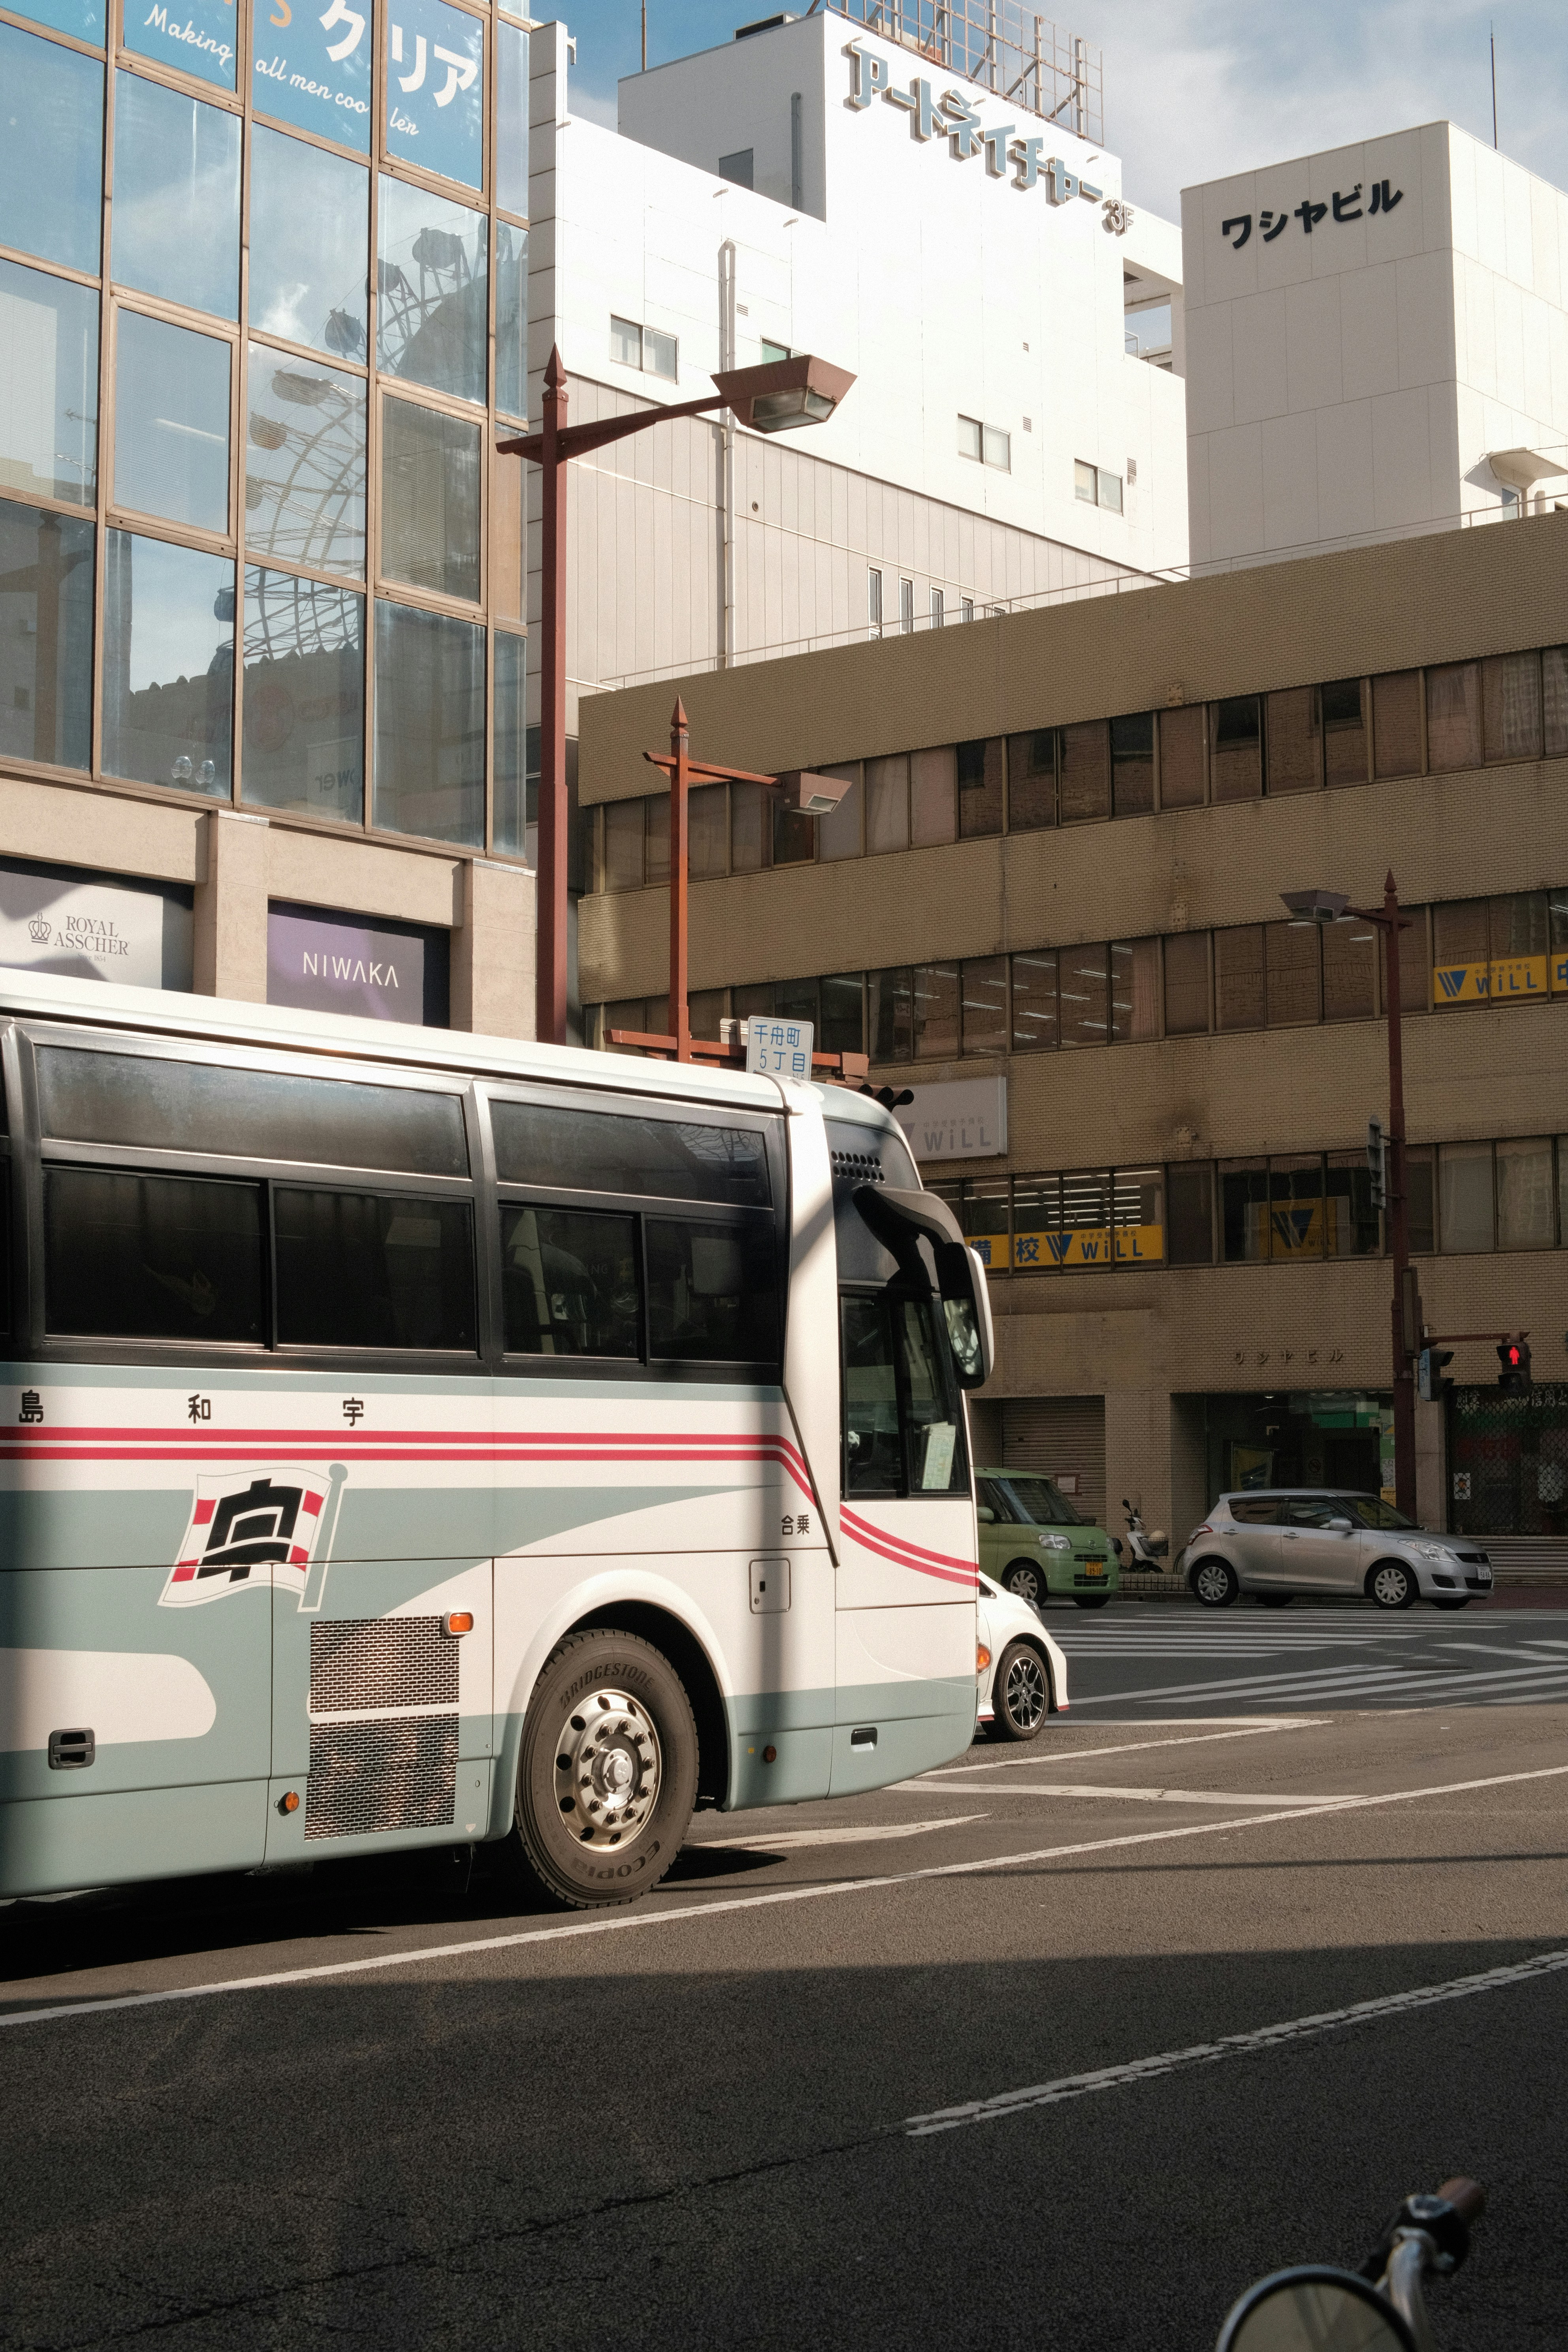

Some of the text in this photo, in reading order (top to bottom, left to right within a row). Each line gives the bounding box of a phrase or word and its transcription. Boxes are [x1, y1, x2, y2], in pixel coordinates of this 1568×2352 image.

[144, 4, 233, 66] Making
[256, 56, 286, 80] all
[290, 73, 332, 99] men
[1107, 199, 1135, 234] 3F
[66, 915, 119, 937] ROYAL
[54, 932, 129, 955] ASSCHER
[303, 951, 399, 988] NIWAKA
[754, 1025, 800, 1047] 千舟町
[759, 1049, 806, 1072] 5丁目
[559, 1662, 655, 1712] BRIDGESTONE
